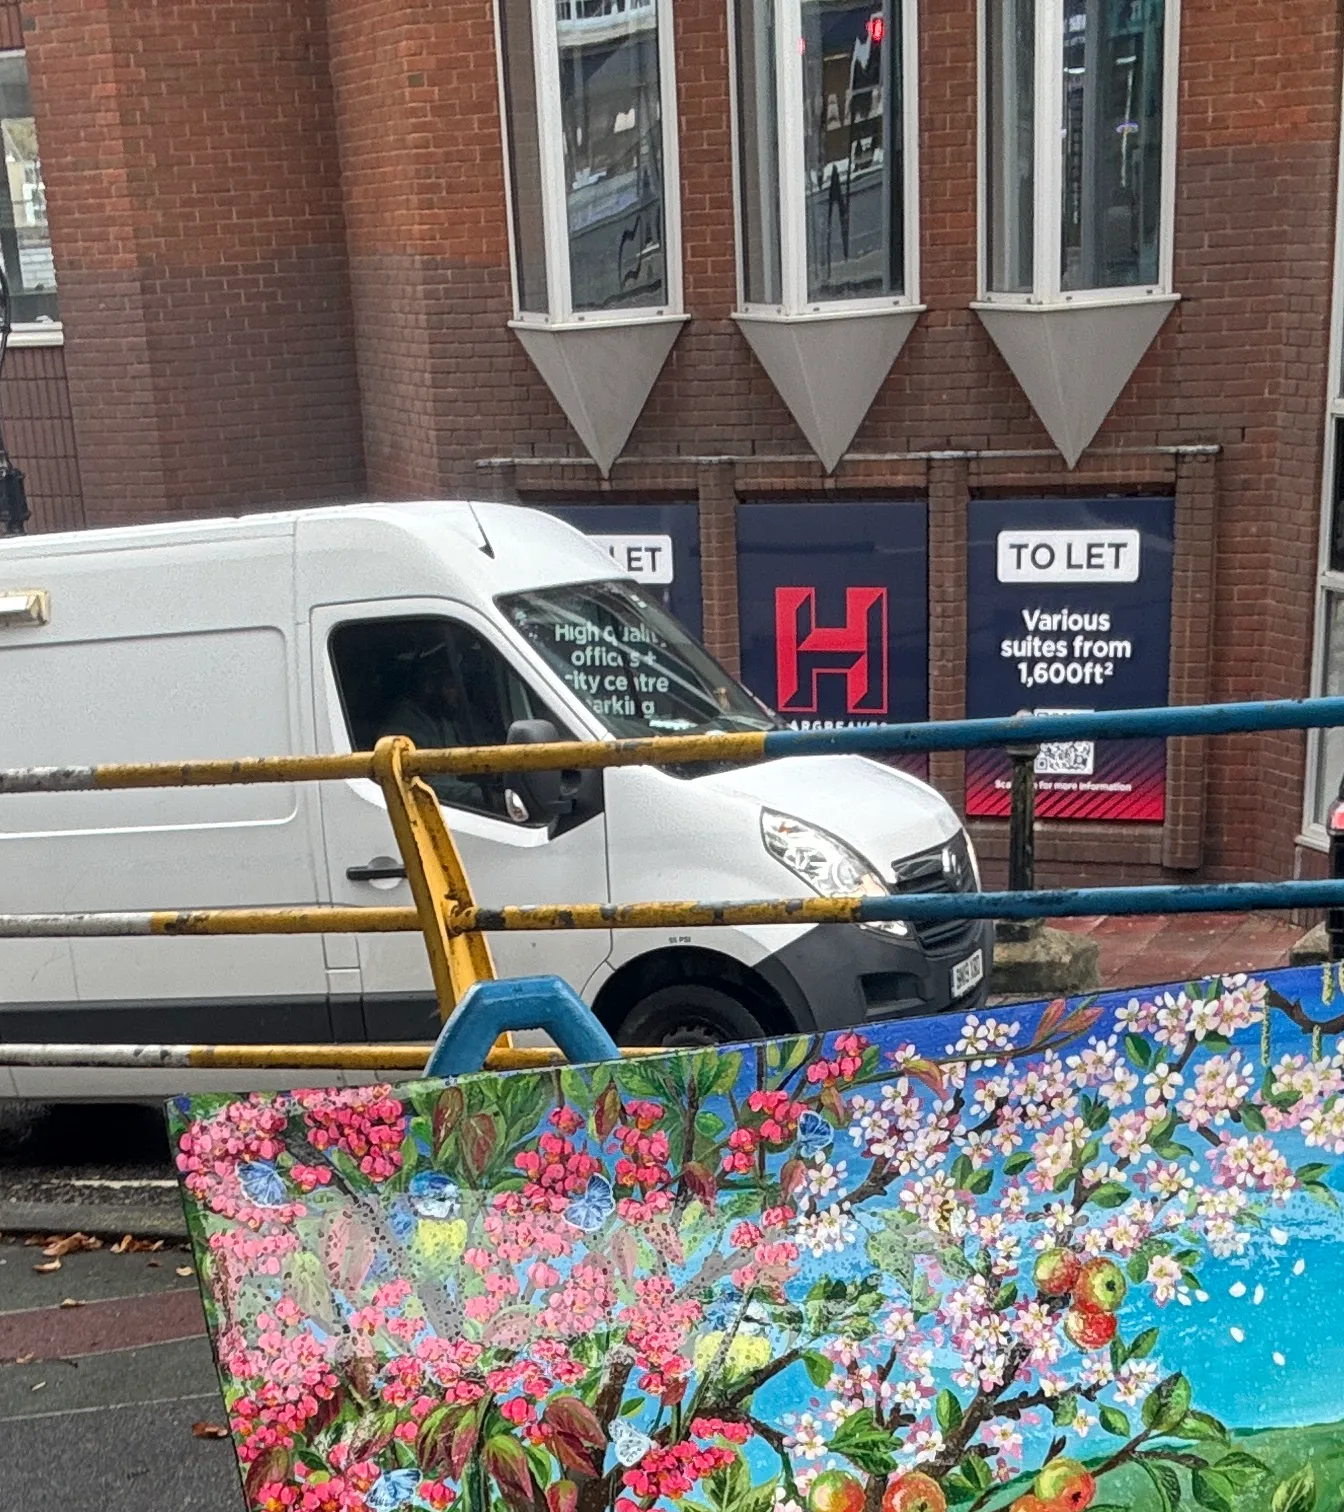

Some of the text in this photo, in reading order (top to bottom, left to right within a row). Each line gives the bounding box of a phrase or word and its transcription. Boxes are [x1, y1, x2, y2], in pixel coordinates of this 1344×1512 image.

[609, 546, 662, 573] ET
[1009, 542, 1128, 570] TO LET
[1022, 608, 1111, 632] Various
[555, 622, 600, 645] High
[1000, 635, 1132, 658] suites from
[1017, 661, 1114, 688] 1,600ft²
[1038, 781, 1053, 790] for
[1054, 781, 1078, 791] more
[1079, 782, 1132, 792] information
